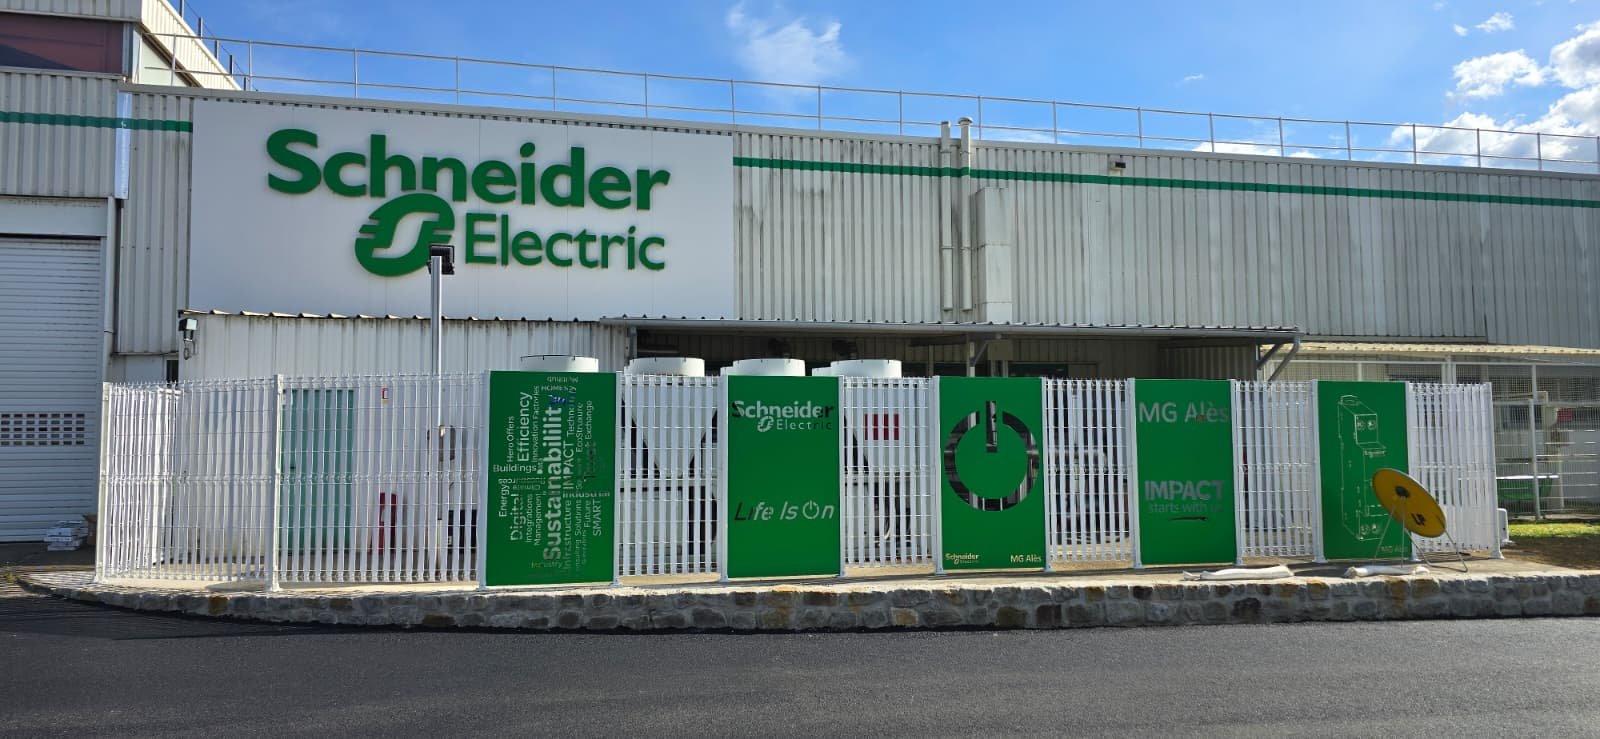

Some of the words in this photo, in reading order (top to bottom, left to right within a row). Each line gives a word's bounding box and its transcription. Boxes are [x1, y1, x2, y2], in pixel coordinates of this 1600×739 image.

[266, 128, 670, 210] Schneider
[465, 213, 665, 271] Electric
[585, 400, 594, 439] Exchange
[732, 400, 834, 418] Schneider
[776, 419, 832, 430] Electric
[1139, 402, 1177, 423] MG
[1184, 401, 1230, 423] Alès
[517, 392, 533, 461] Efficiency
[493, 464, 537, 473] Buildings
[563, 440, 574, 489] IMPACT
[498, 485, 510, 517] Energy
[1144, 480, 1225, 501] IMPACT
[1150, 502, 1180, 512] starts
[1183, 501, 1207, 512] with
[510, 493, 526, 541] Digital
[526, 494, 534, 542] Integrations
[534, 493, 542, 546] Management
[574, 500, 582, 536] Solutions
[592, 500, 602, 536] SMART
[734, 501, 774, 520] Life
[780, 500, 799, 520] Is
[945, 553, 979, 562] Schneider
[1010, 555, 1024, 563] MG
[1026, 554, 1042, 562] Alès
